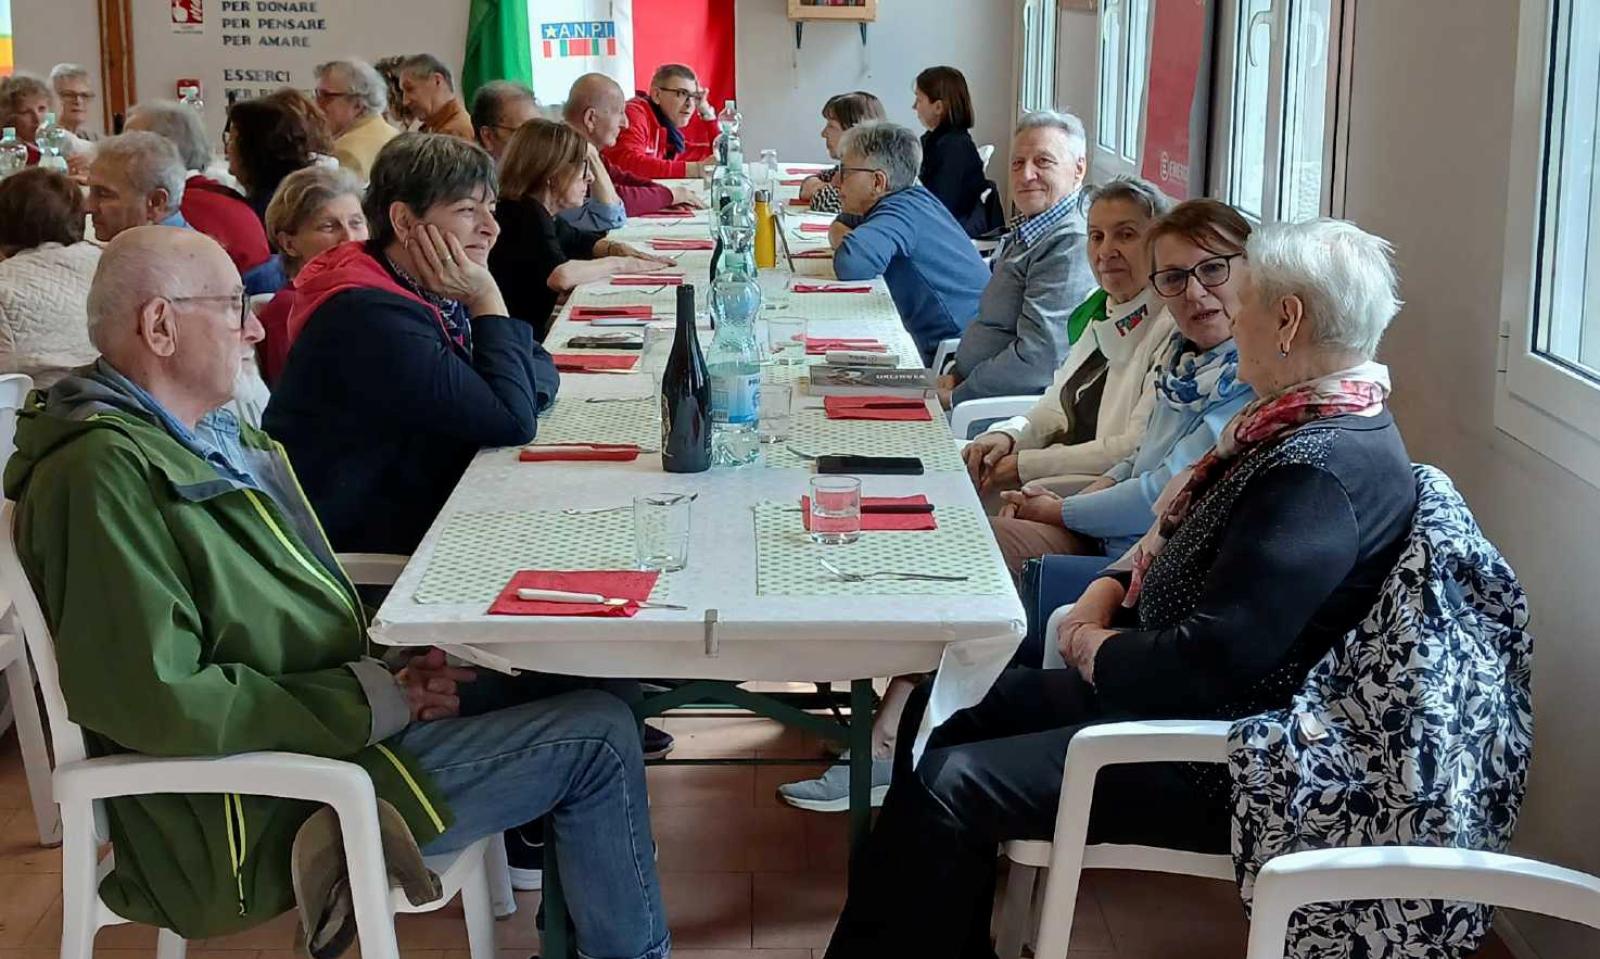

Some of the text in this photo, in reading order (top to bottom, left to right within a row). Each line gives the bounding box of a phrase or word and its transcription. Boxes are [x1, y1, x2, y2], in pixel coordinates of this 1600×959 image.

[222, 1, 317, 12] PER DONARE
[222, 18, 326, 30] PER PENSARE
[223, 35, 311, 47] PER AMARE
[224, 69, 290, 82] ESSERCI
